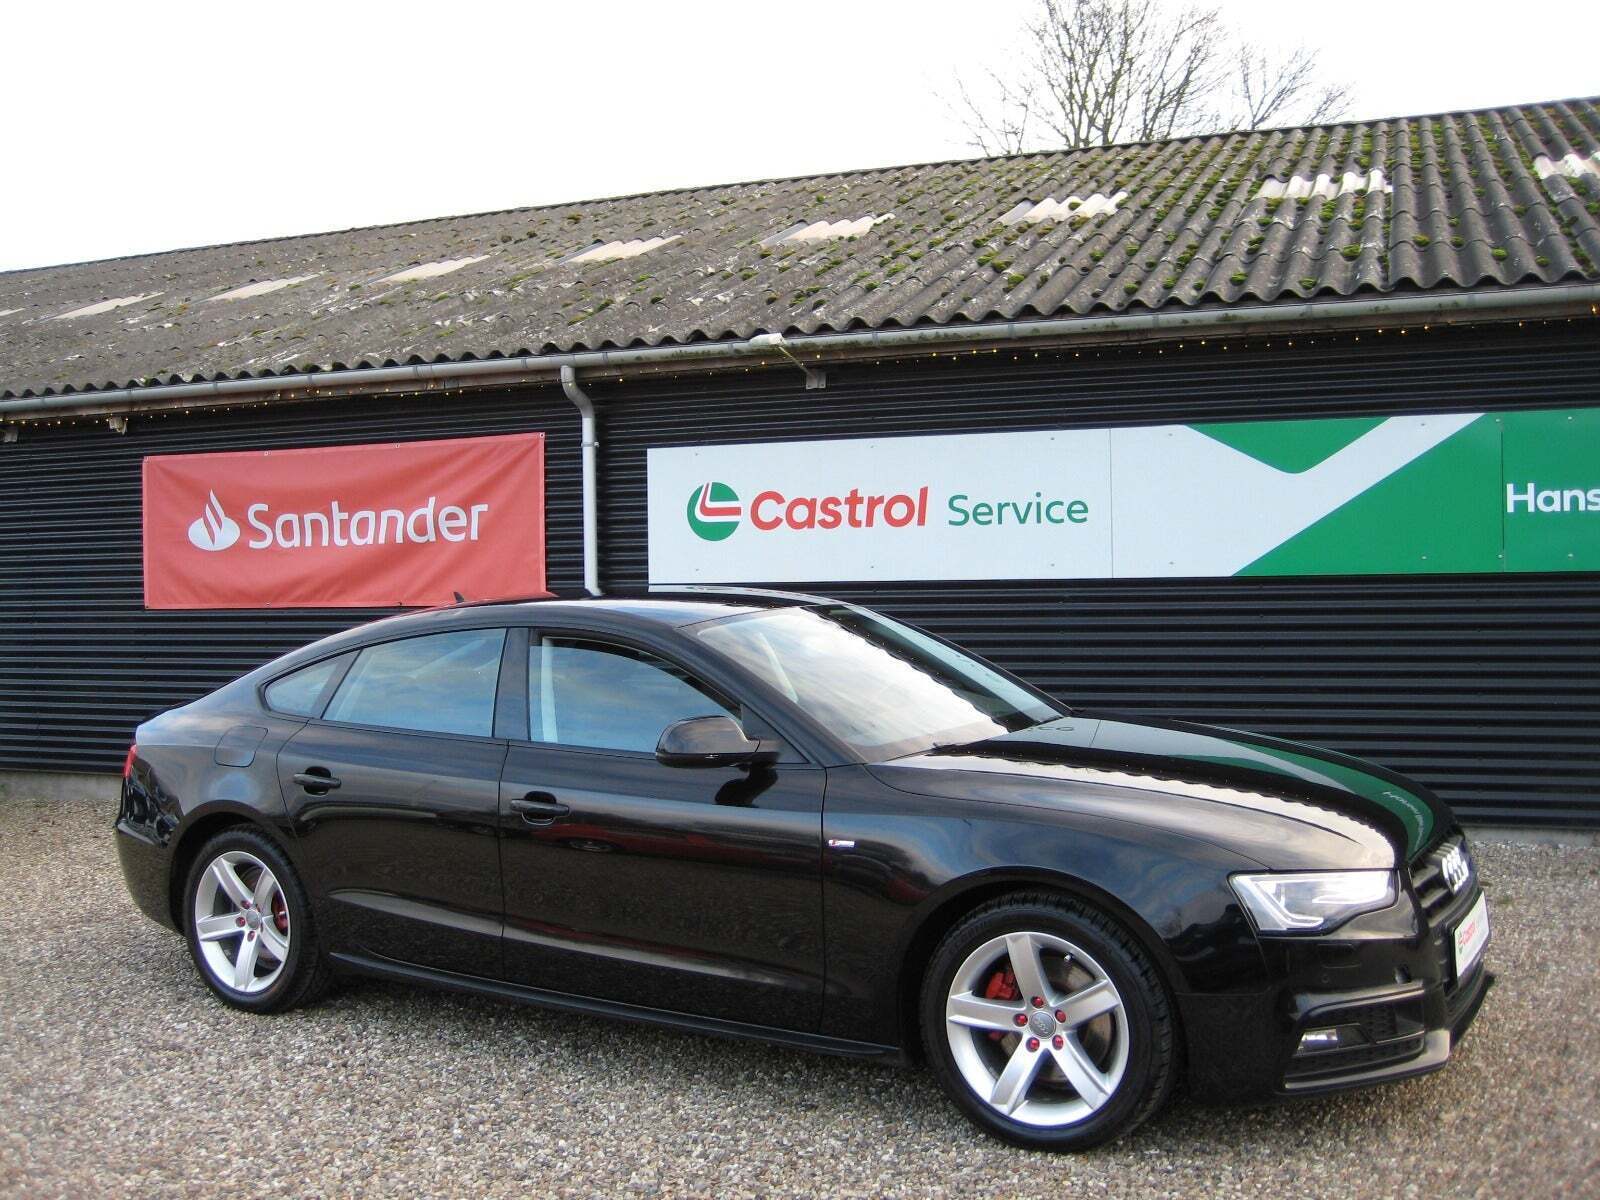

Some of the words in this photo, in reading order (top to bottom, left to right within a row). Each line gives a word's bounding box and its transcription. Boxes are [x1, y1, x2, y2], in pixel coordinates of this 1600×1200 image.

[247, 497, 489, 549] Santander
[751, 487, 929, 532] Castrol
[948, 491, 1089, 527] Service
